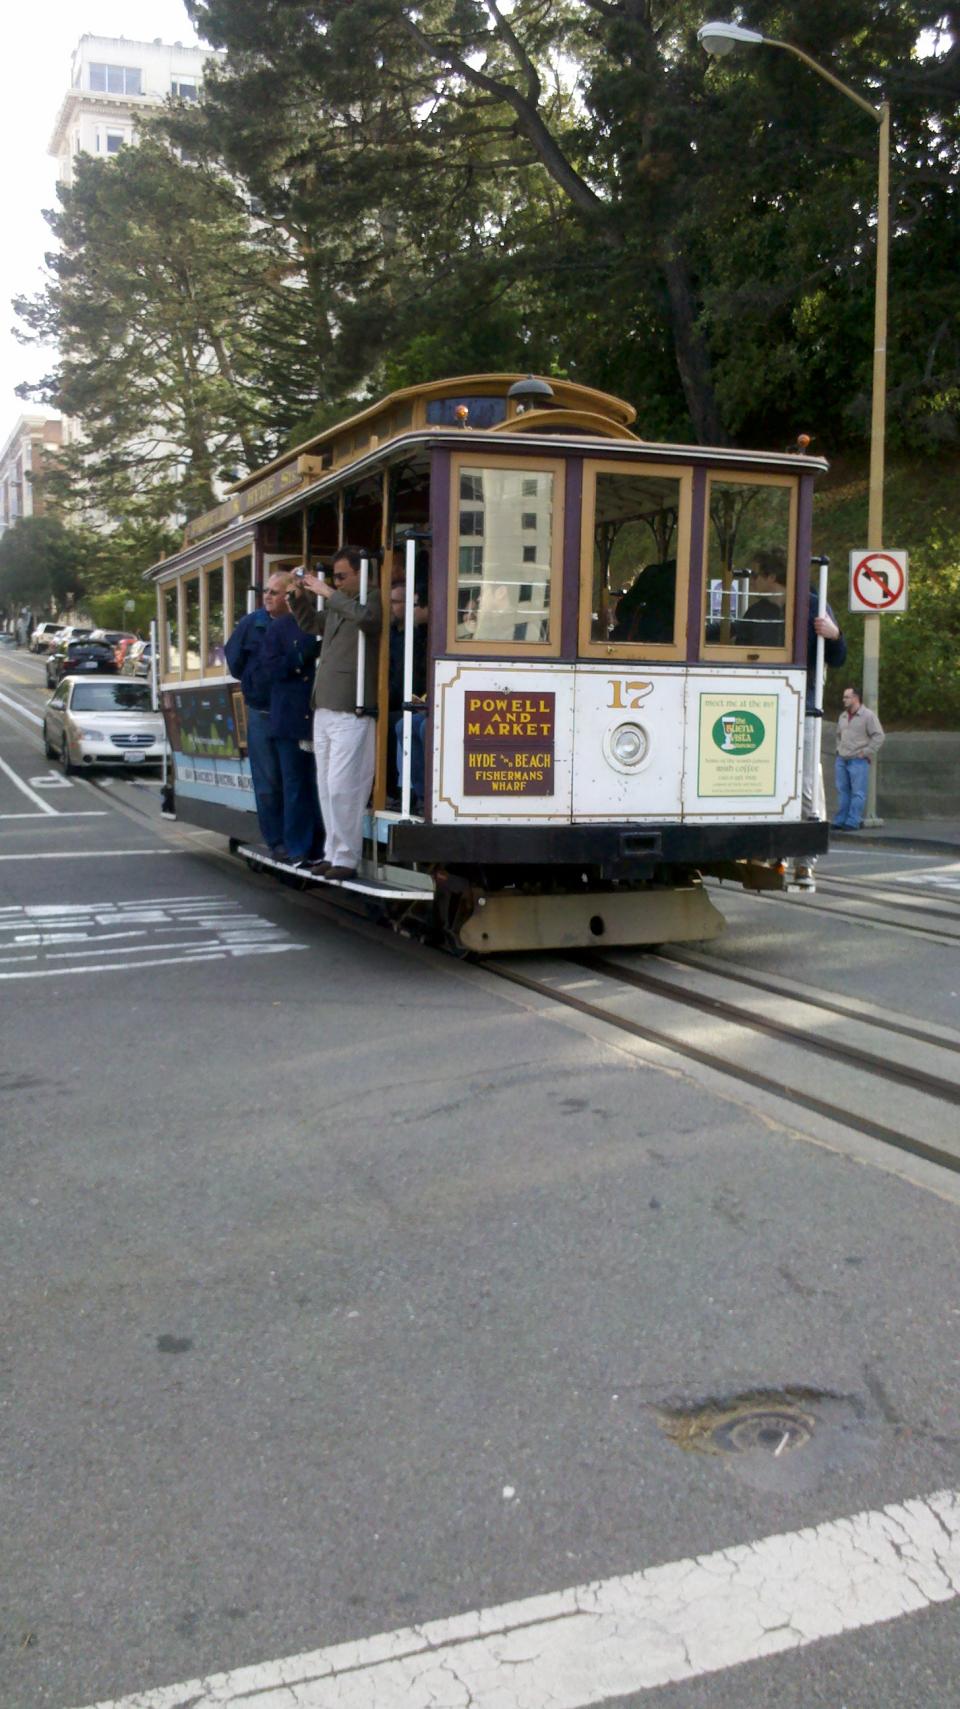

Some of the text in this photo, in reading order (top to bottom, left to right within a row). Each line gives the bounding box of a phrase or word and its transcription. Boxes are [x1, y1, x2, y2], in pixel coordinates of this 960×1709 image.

[607, 680, 654, 708] 17
[469, 699, 550, 712] POWELL
[491, 713, 531, 722] AND
[468, 723, 551, 736] MARKET
[469, 753, 551, 768] HYDE AND BEACH
[475, 770, 544, 781] FISHERMANS
[492, 781, 527, 791] WHARF
